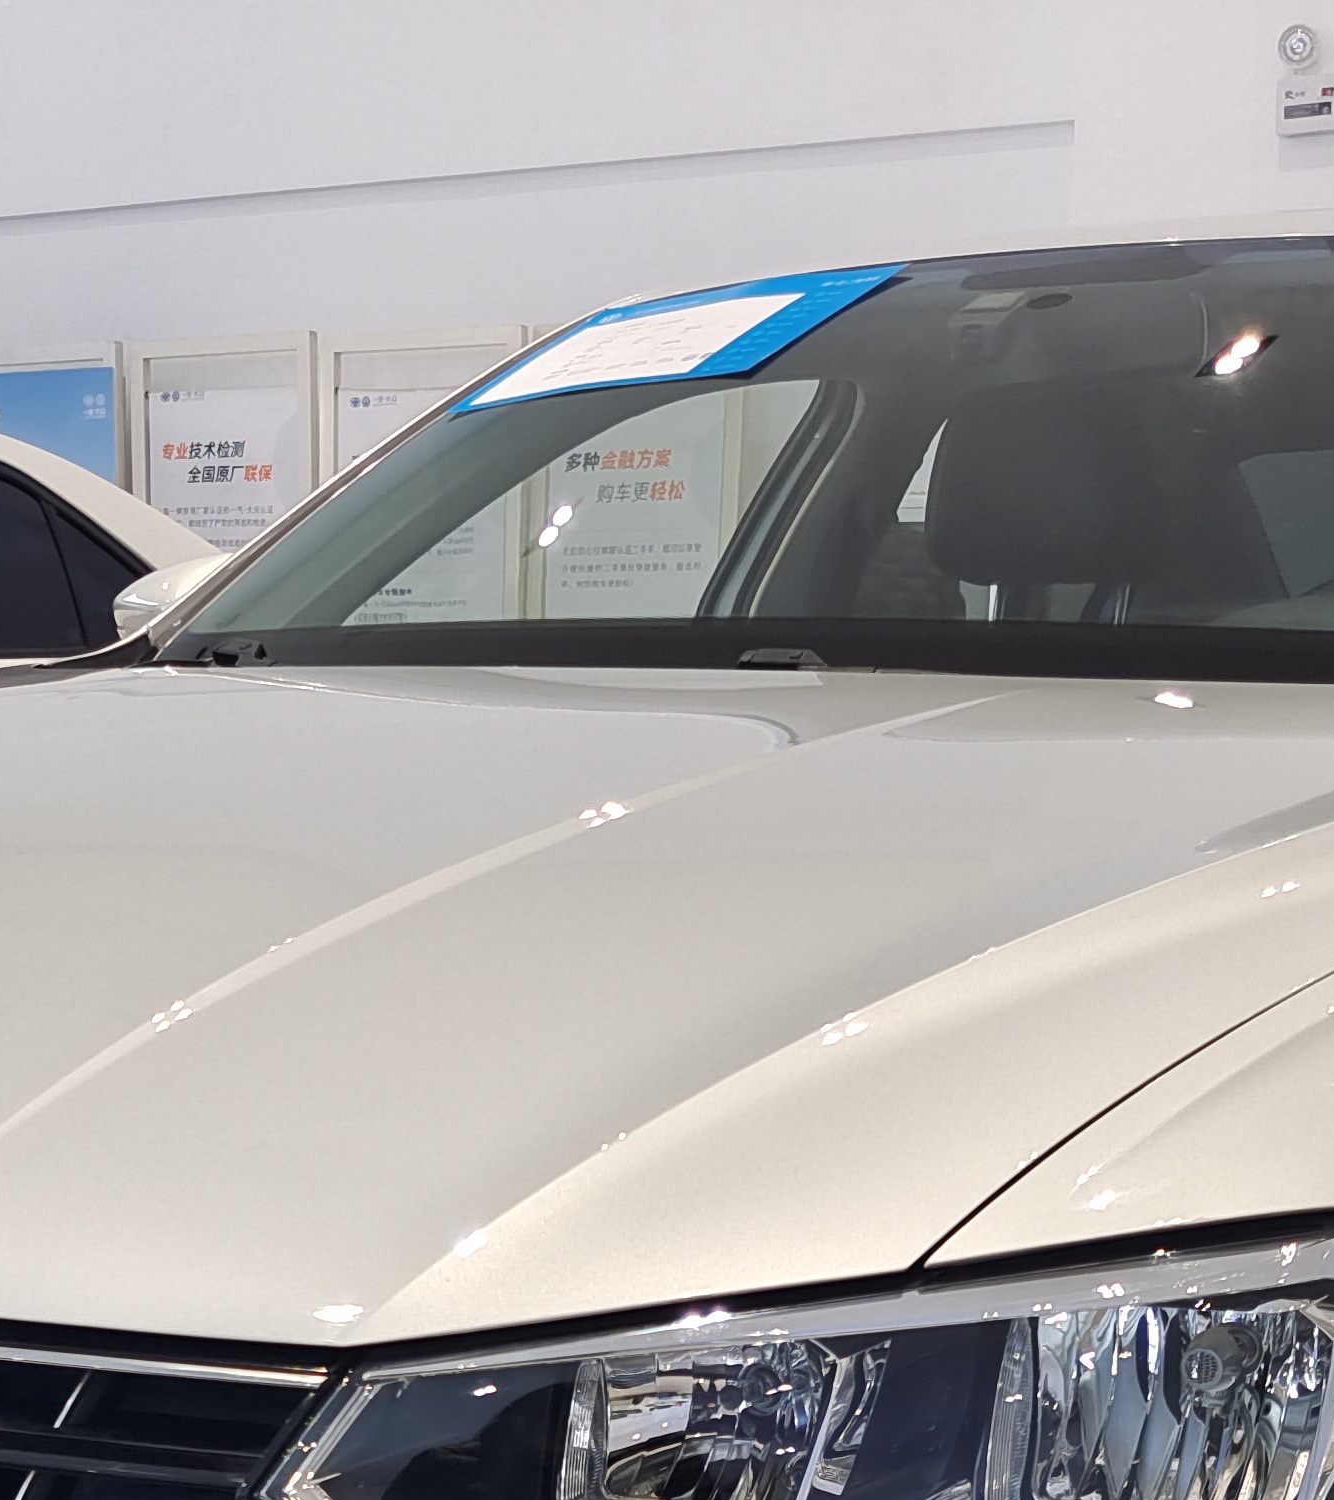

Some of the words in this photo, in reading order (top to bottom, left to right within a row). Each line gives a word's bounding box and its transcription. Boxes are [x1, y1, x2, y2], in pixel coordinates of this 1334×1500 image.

[161, 439, 246, 460] 专业技术检测
[564, 448, 672, 473] 多种金融方案
[186, 464, 273, 484] 全国原厂联保
[595, 479, 685, 504] 购车更轻松
